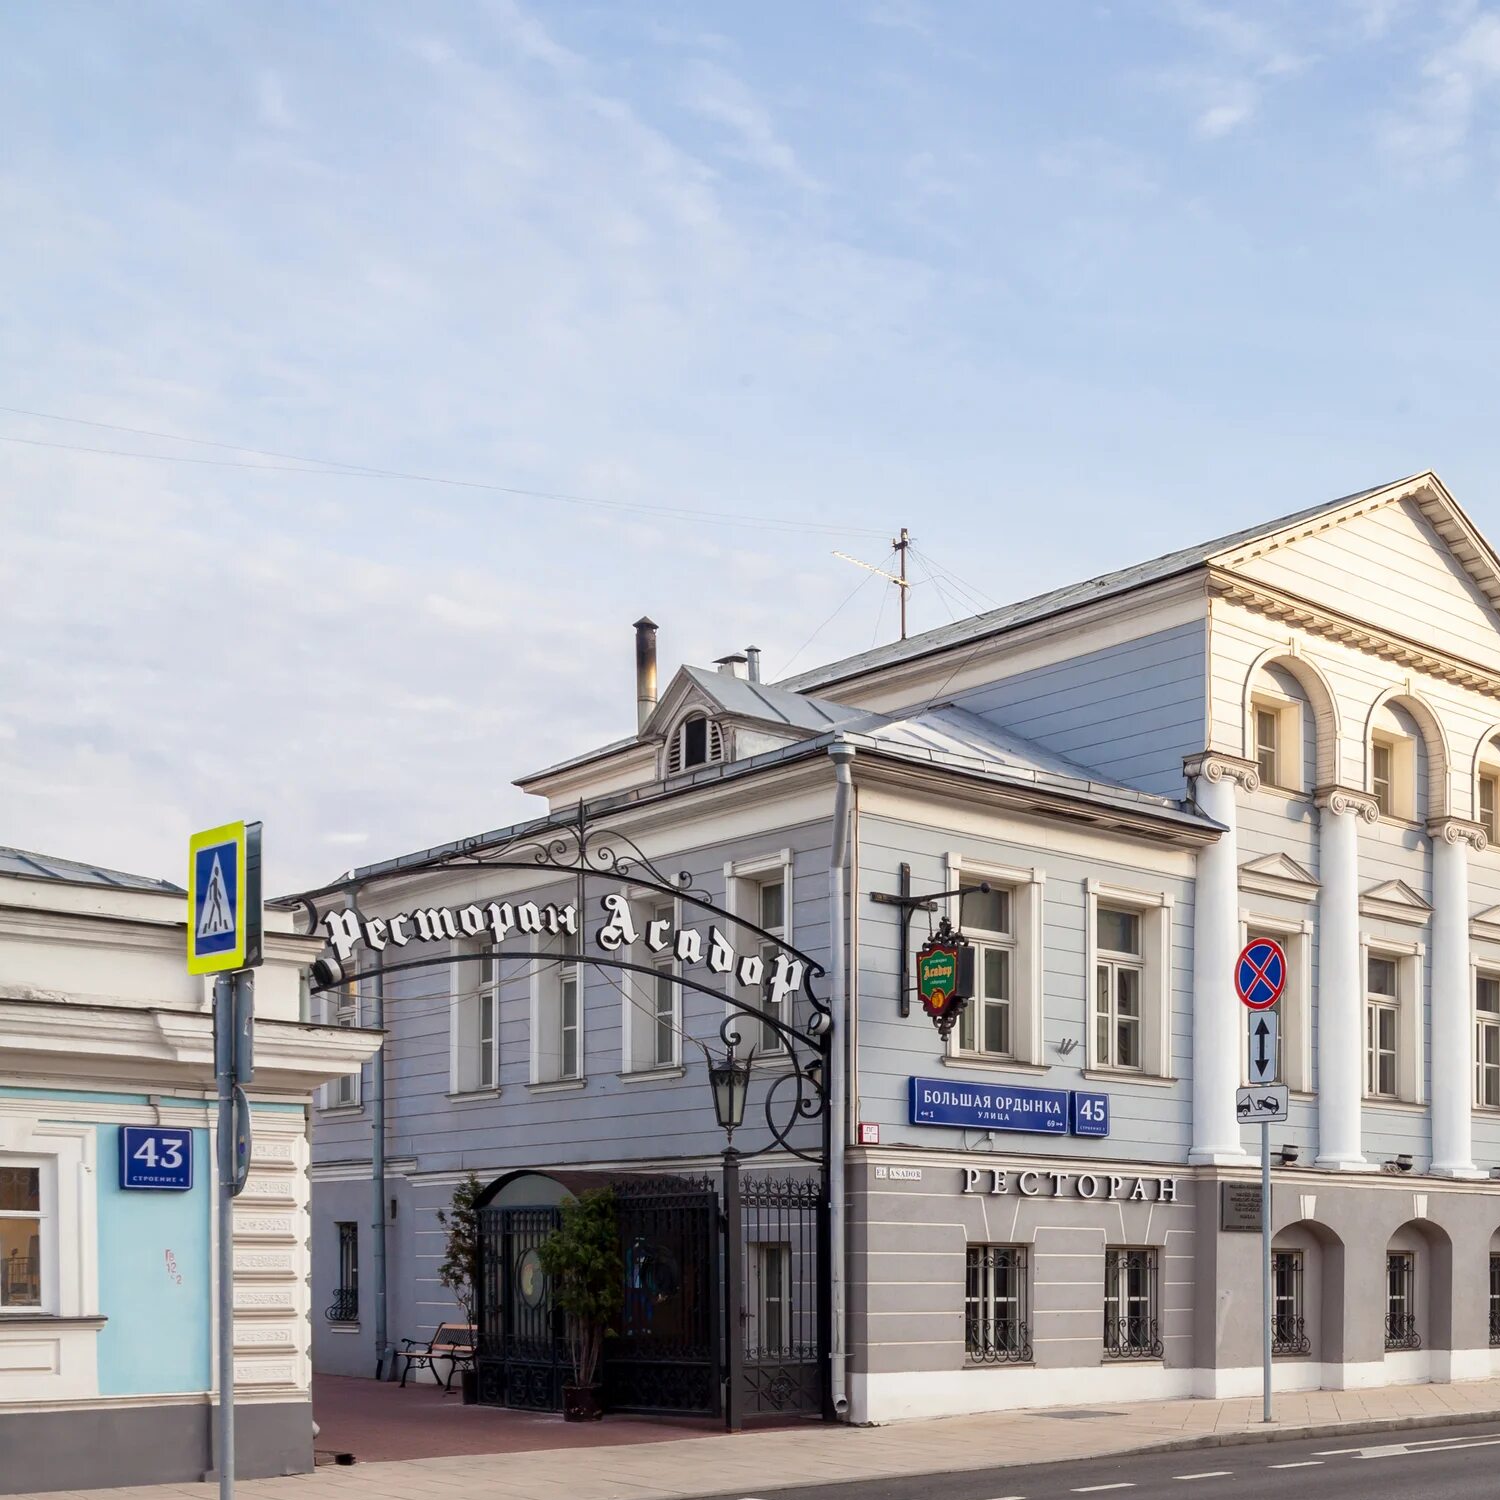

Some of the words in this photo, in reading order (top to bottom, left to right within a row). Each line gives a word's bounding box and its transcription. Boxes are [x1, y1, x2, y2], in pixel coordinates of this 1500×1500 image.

[321, 901, 578, 961] Ресторан
[596, 894, 804, 1003] Асадор
[924, 1090, 991, 1109] БОЛЬШАЯ
[995, 1096, 1061, 1114] ОРДЫНКА
[1080, 1099, 1105, 1121] 45
[977, 1111, 1010, 1121] УЛИЦА
[1046, 1119, 1055, 1127] 69
[133, 1137, 183, 1168] 43
[132, 1175, 177, 1183] СТРОЕНИЕ
[876, 1167, 886, 1177] EL
[889, 1168, 921, 1179] ASADOR
[962, 1167, 1178, 1201] РЕСТОРАН
